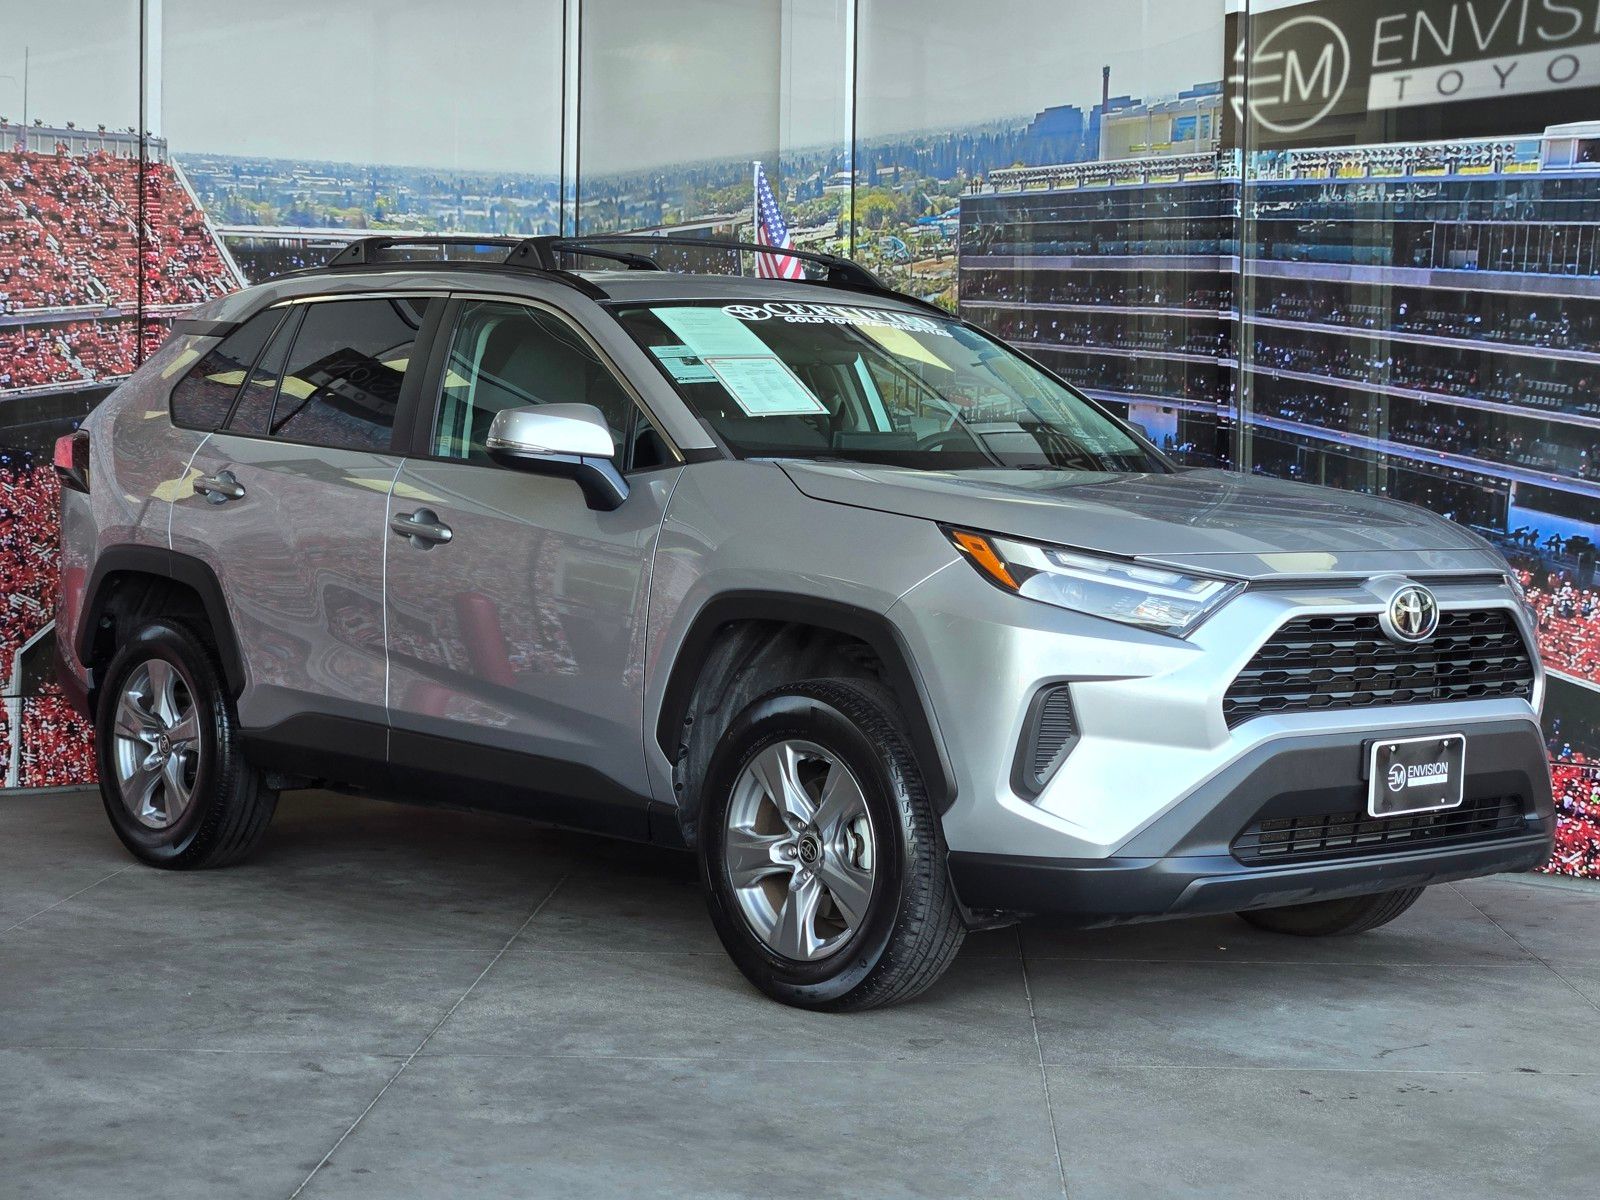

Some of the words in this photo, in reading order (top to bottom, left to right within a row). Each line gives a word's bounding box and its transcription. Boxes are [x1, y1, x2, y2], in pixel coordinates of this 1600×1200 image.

[1392, 54, 1581, 102] TOYO
[762, 302, 938, 329] CERTIFIED
[783, 316, 825, 324] GOLD
[1407, 761, 1449, 778] ENVISION
